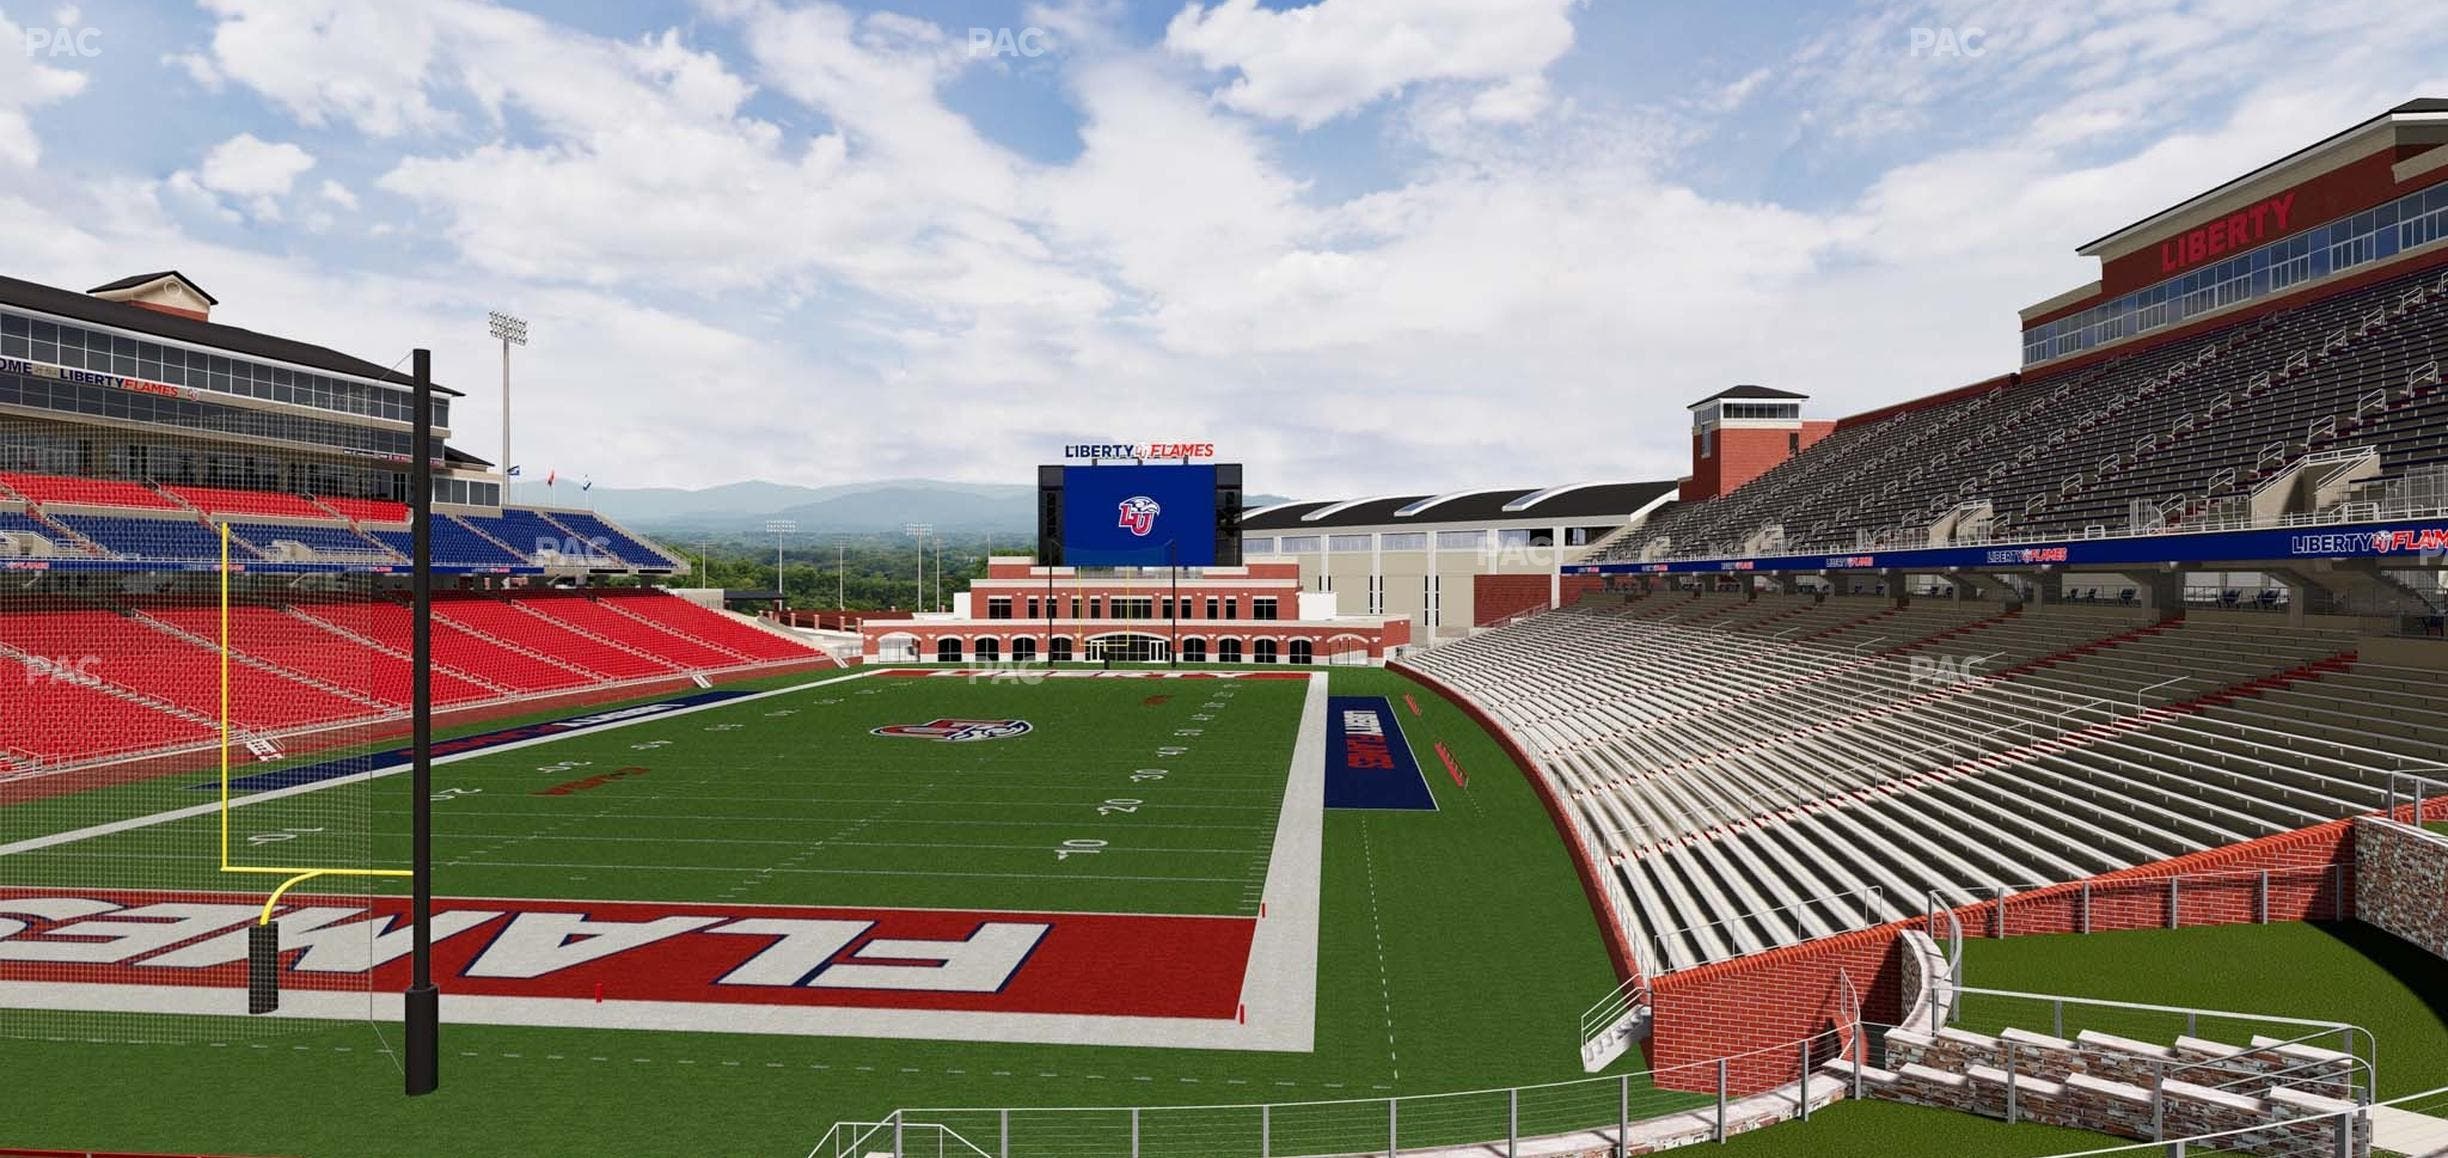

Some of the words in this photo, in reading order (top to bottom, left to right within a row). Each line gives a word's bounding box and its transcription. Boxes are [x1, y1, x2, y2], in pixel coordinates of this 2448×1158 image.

[2161, 192, 2296, 272] LIBERTY
[1065, 444, 1134, 458] LIBERTY
[1150, 443, 1214, 457] FLAMES
[2292, 532, 2371, 553] LIBERTY
[1097, 799, 1144, 815] 20
[1054, 839, 1109, 857] 10
